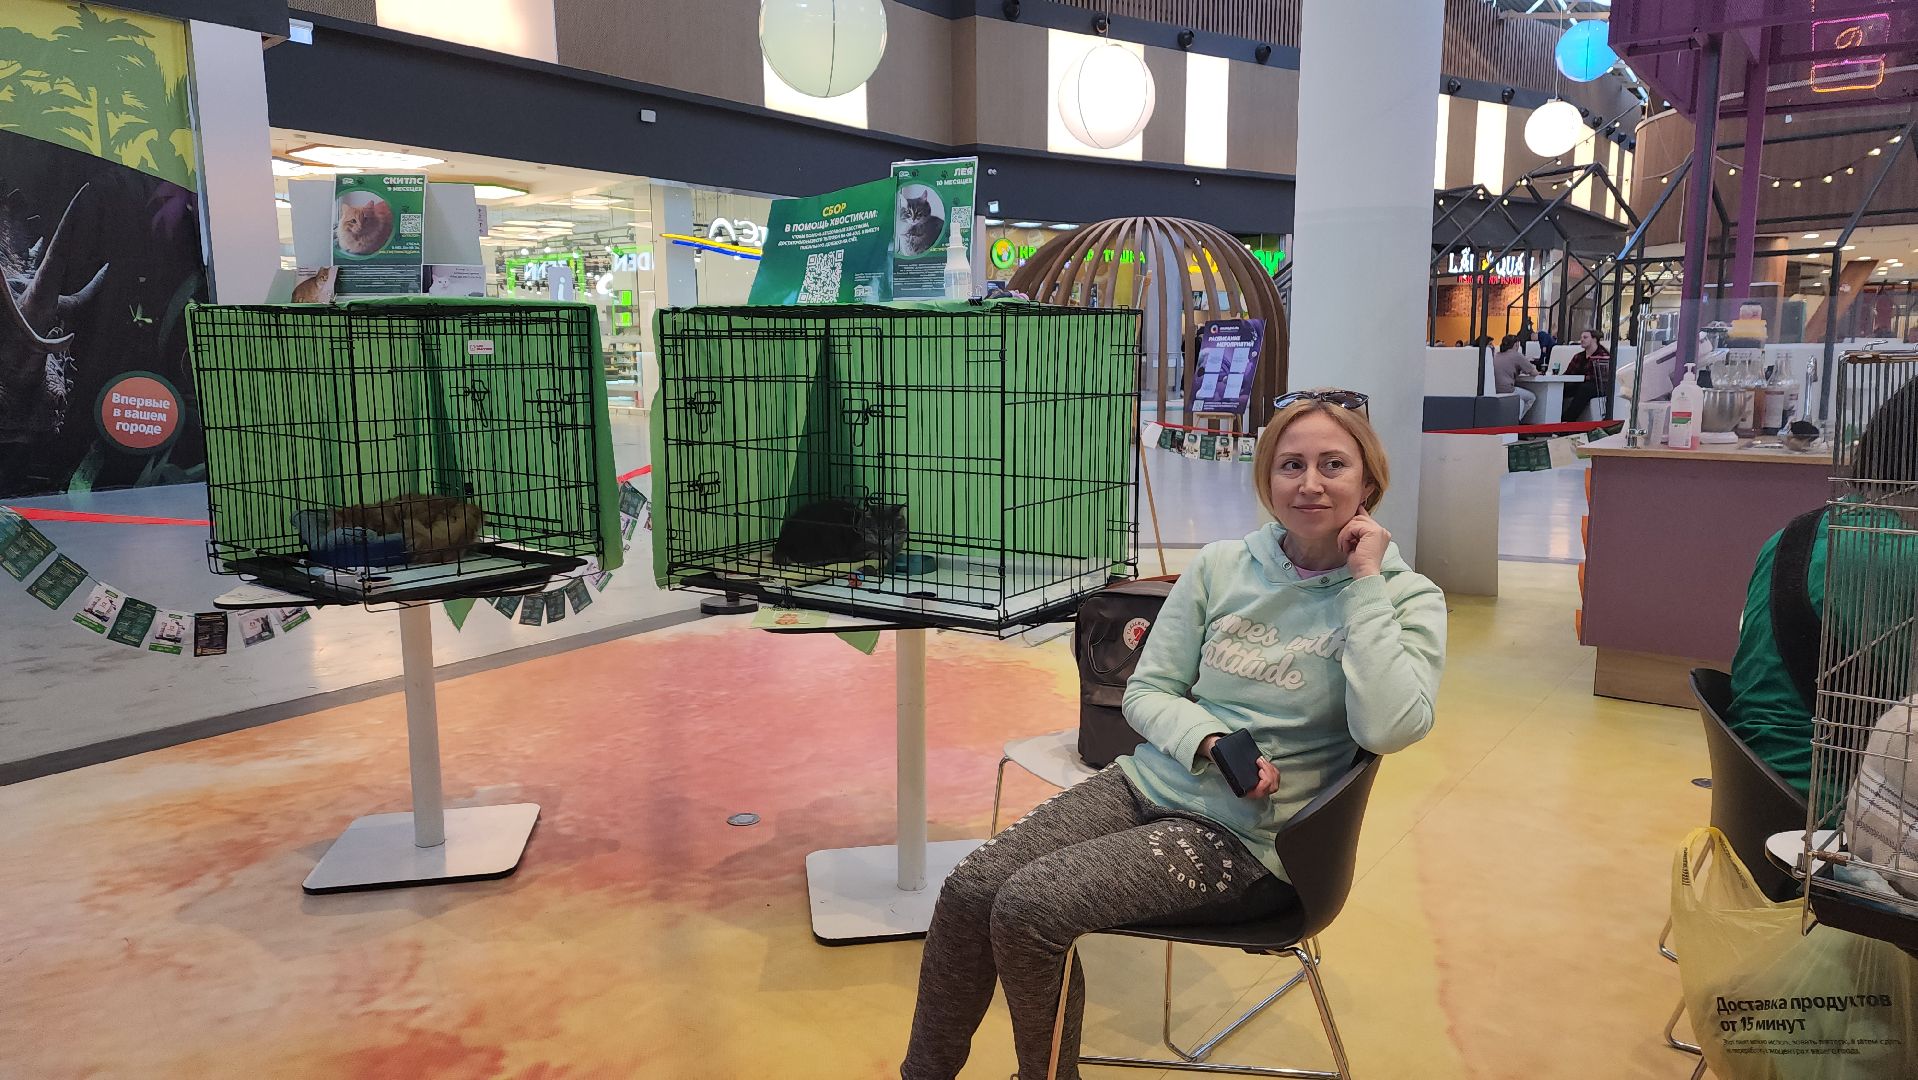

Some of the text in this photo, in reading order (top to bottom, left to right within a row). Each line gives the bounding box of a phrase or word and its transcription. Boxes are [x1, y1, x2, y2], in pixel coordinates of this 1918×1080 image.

[954, 167, 974, 176] ЛЕЯ
[383, 177, 423, 185] СКИТЛС
[822, 202, 847, 217] СБОР
[784, 223, 791, 233] В
[792, 219, 829, 232] ПОМОЩЬ
[111, 392, 171, 410] Впервые
[113, 408, 167, 422] в вашем
[115, 421, 162, 435] городе
[1716, 994, 1893, 1016] Доставка продуктов
[1720, 1016, 1807, 1034] от 15 минут
